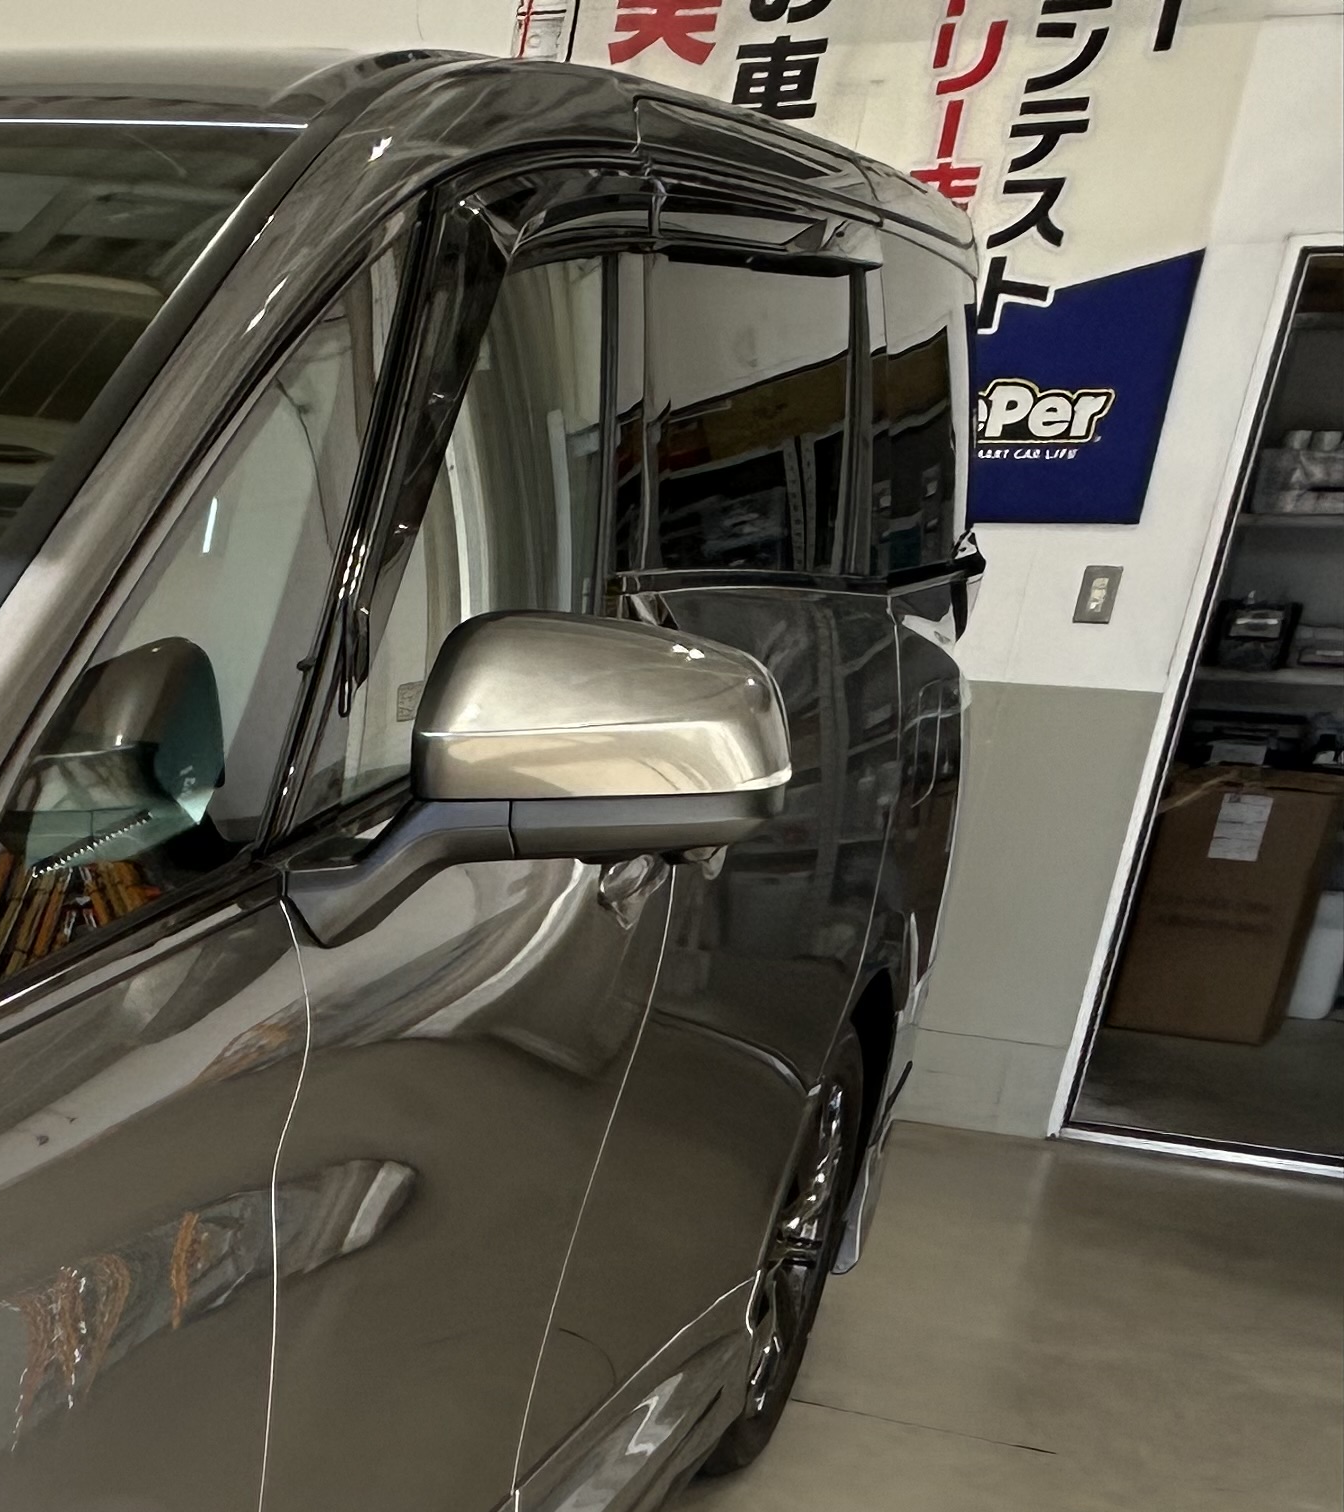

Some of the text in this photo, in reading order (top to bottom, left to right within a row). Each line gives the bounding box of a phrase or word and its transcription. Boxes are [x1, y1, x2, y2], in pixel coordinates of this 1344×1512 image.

[910, 0, 1008, 211] リー
[977, 0, 1113, 329] ンテスト
